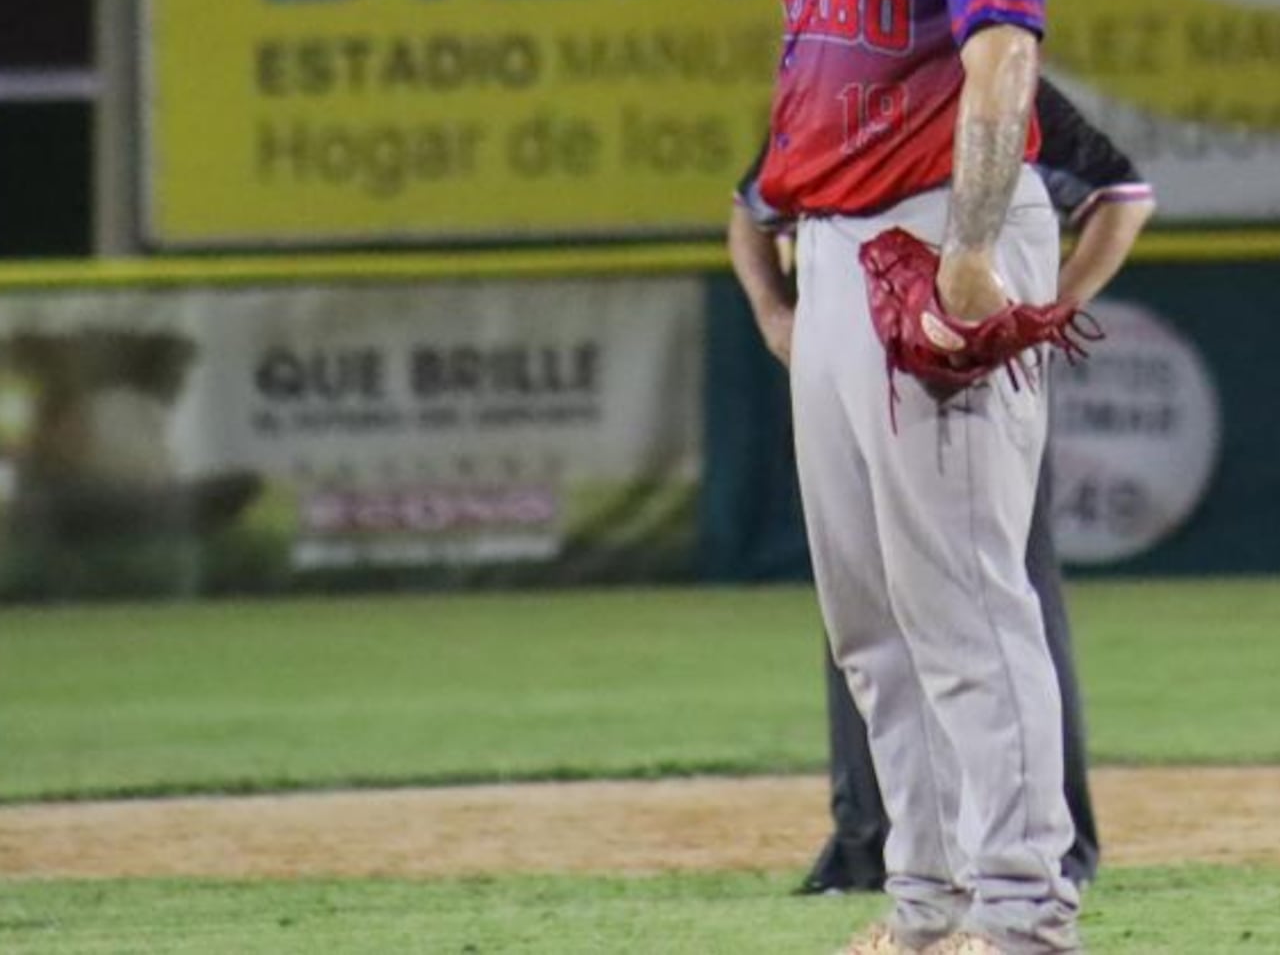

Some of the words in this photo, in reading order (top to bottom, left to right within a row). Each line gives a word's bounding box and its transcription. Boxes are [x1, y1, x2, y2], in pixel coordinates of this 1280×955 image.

[254, 33, 542, 97] ESTADIO
[256, 116, 484, 198] Hogar
[507, 107, 603, 181] de
[618, 101, 738, 174] los
[252, 345, 388, 403] QUE
[410, 338, 602, 397] BRILLE
